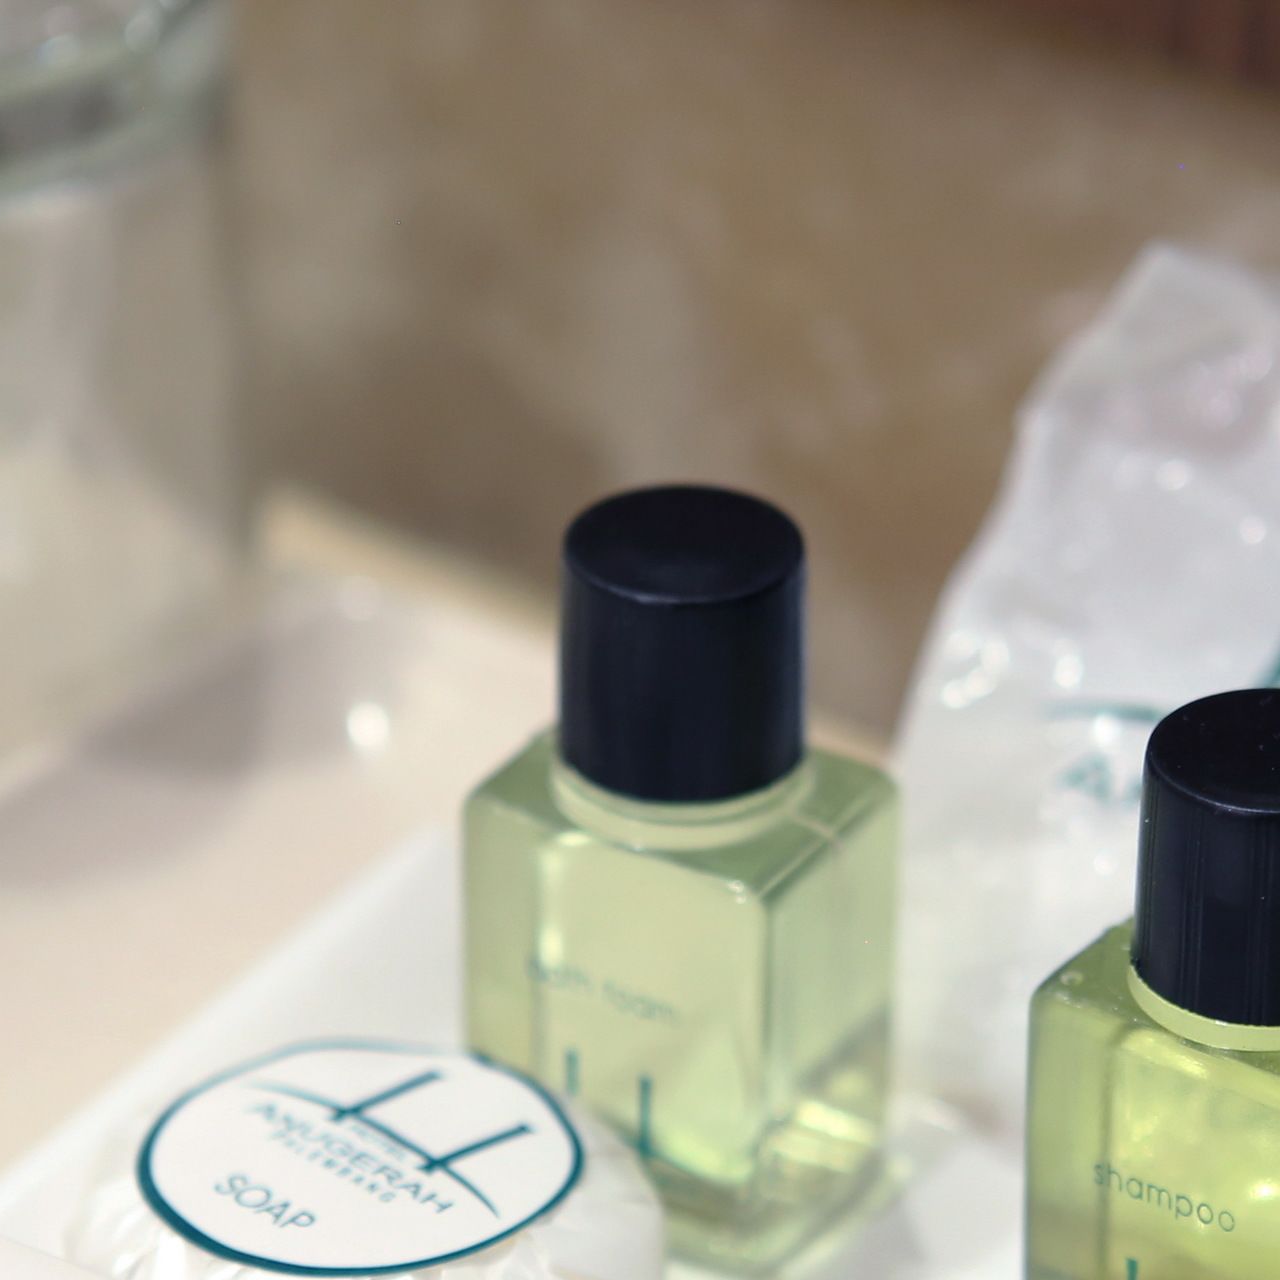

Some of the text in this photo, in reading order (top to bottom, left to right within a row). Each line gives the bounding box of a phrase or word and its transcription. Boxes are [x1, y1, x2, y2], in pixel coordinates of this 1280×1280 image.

[249, 1100, 457, 1215] ANUGERAH
[214, 1173, 317, 1232] SOAP
[1093, 1161, 1236, 1233] shampoo
